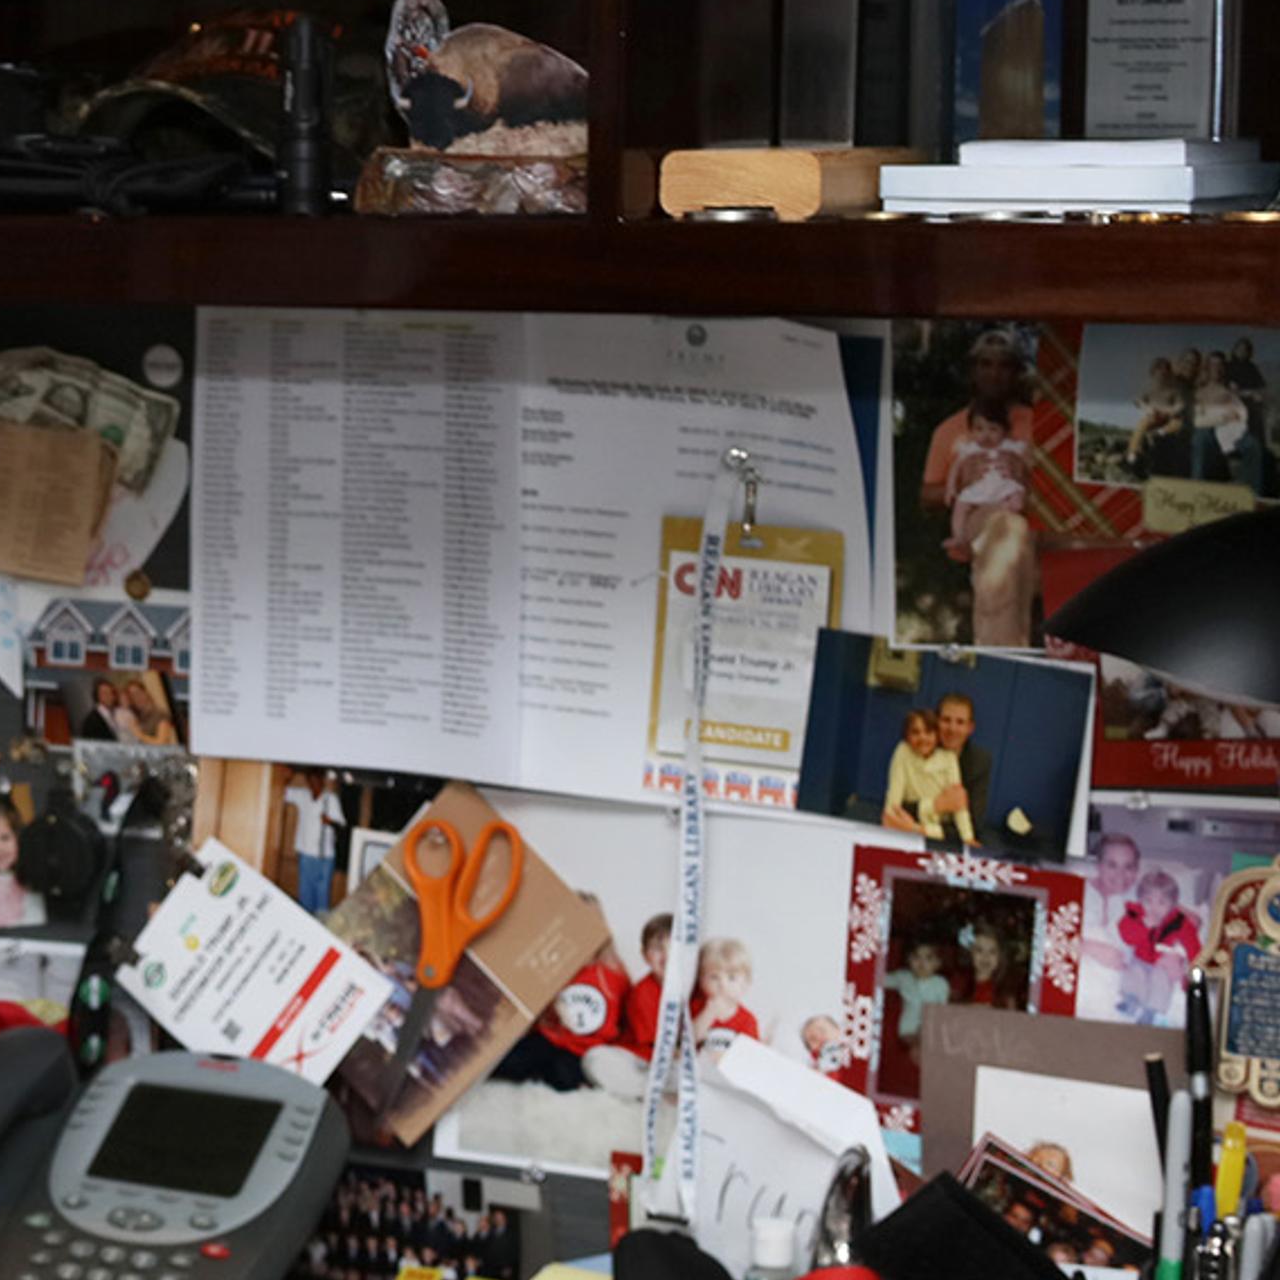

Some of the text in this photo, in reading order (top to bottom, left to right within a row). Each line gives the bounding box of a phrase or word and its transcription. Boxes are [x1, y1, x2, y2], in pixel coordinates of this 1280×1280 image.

[673, 561, 743, 600] CN
[703, 723, 785, 748] ANDIDATE
[682, 772, 701, 945] REAGAN LIBRARY
